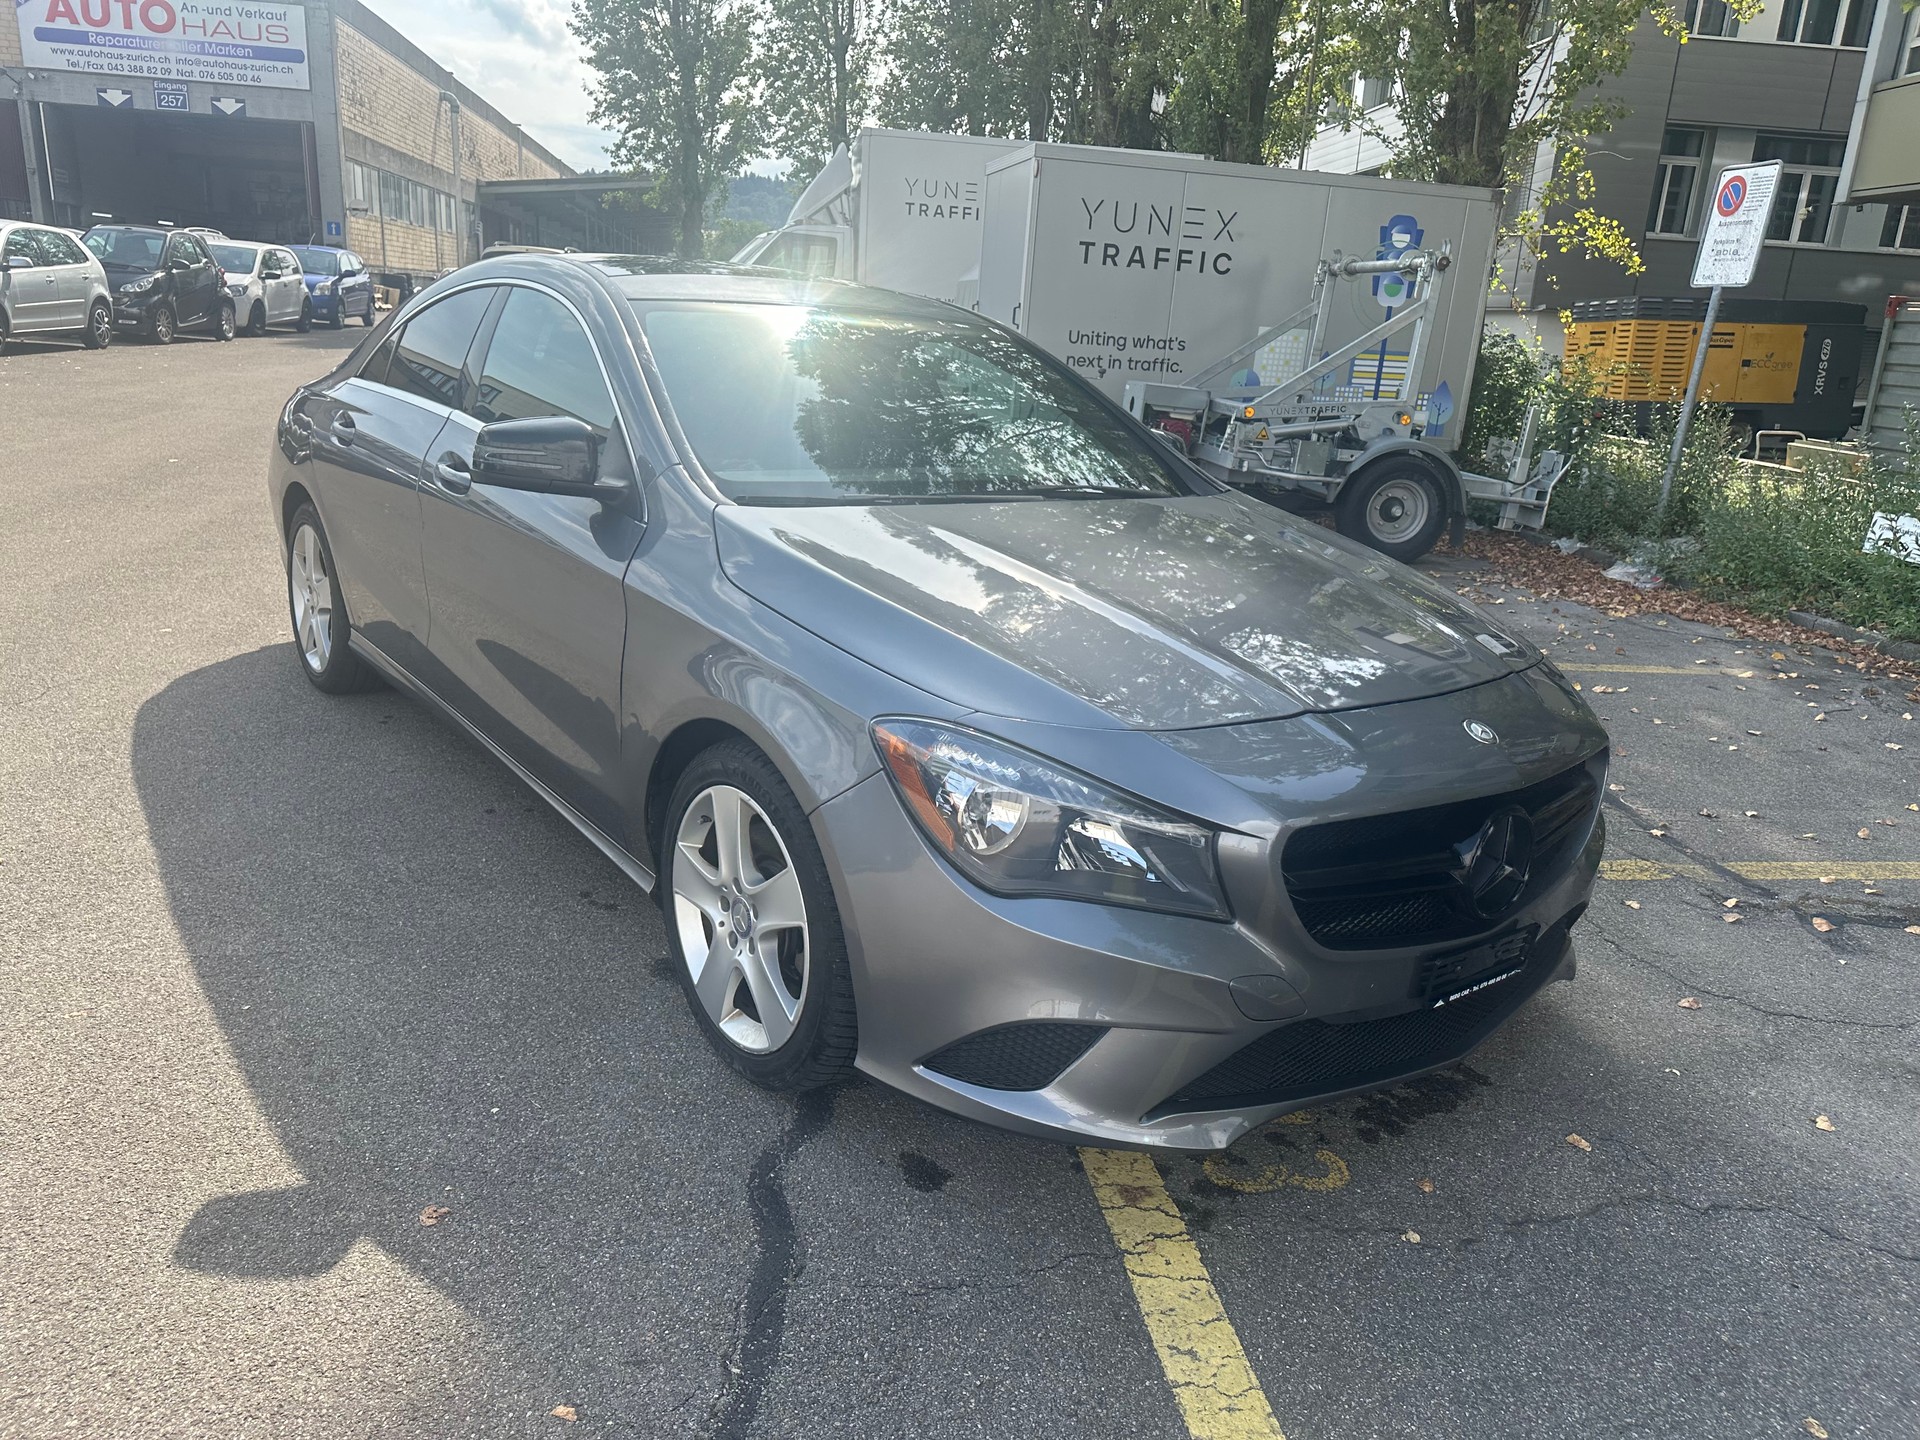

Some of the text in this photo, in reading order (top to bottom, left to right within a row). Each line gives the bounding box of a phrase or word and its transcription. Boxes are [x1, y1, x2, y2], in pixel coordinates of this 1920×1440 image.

[45, 0, 177, 34] AUTO
[180, 3, 198, 14] An
[235, 7, 288, 22] Verkauf
[181, 17, 290, 44] HAUS
[88, 32, 167, 50] Reparature
[204, 43, 253, 57] Marken
[50, 47, 294, 75] www.autohaus-zurich.ch info@autohaus-zurich.ch
[66, 59, 262, 84] Tel./Fax 043 388 82 09 Nat. 076 505 00 46
[153, 81, 188, 92] Eingang
[160, 94, 184, 107] 257
[1081, 197, 1238, 243] YUNEX
[1079, 240, 1233, 276] TRAFFIC
[1068, 329, 1187, 352] Uniting what's
[1066, 354, 1183, 374] next in traffic.
[1813, 340, 1831, 396] XRVS 476
